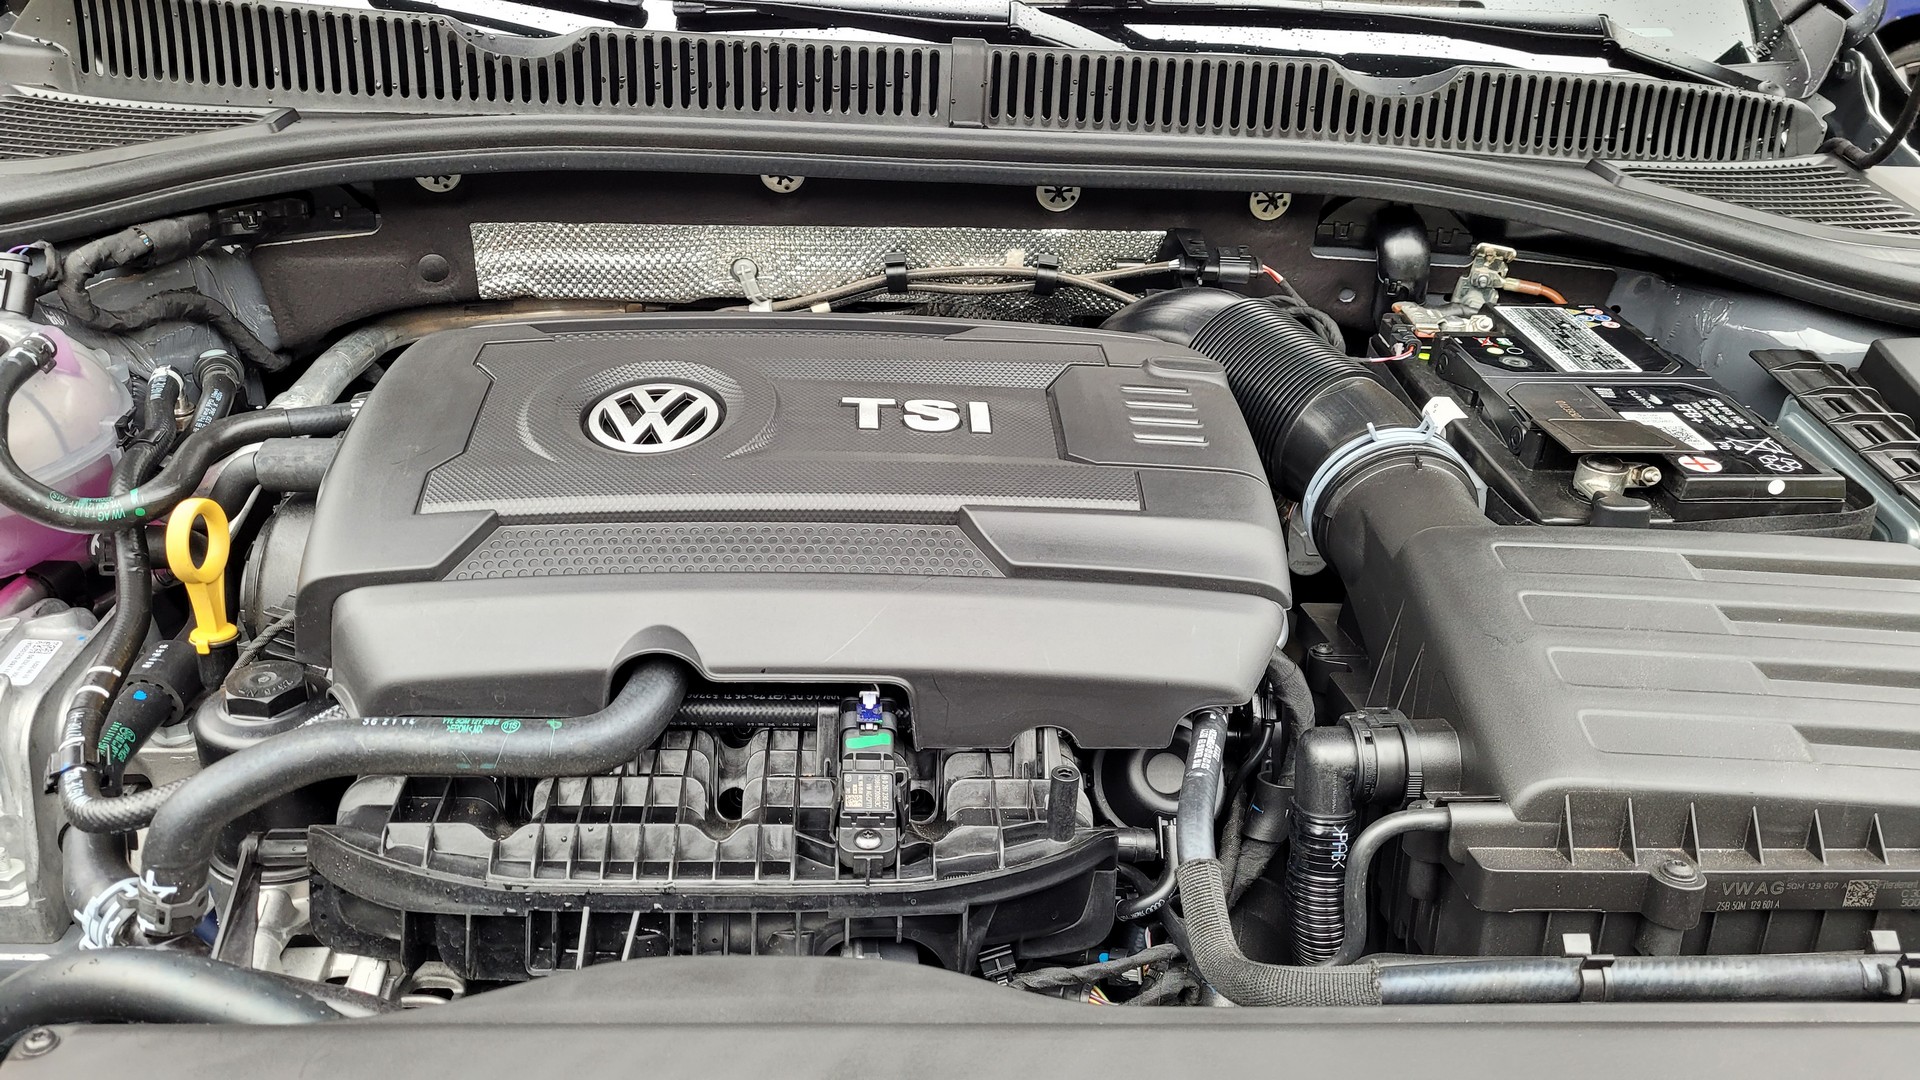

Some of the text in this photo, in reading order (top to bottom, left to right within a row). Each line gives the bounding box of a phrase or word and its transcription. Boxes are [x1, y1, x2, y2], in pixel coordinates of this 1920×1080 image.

[587, 384, 720, 454] VW
[840, 396, 994, 435] TSI
[1672, 403, 1704, 424] EFB+
[44, 503, 97, 518] TRISTONE
[97, 510, 111, 522] AG
[1330, 824, 1349, 869] >PA6<
[1722, 882, 1755, 896] VW
[1755, 881, 1785, 896] AG
[1786, 882, 1805, 890] 5QM
[1808, 882, 1822, 890] 129
[1901, 889, 1910, 898] C
[1716, 900, 1780, 911] ZSB 5QM 129 601 A
